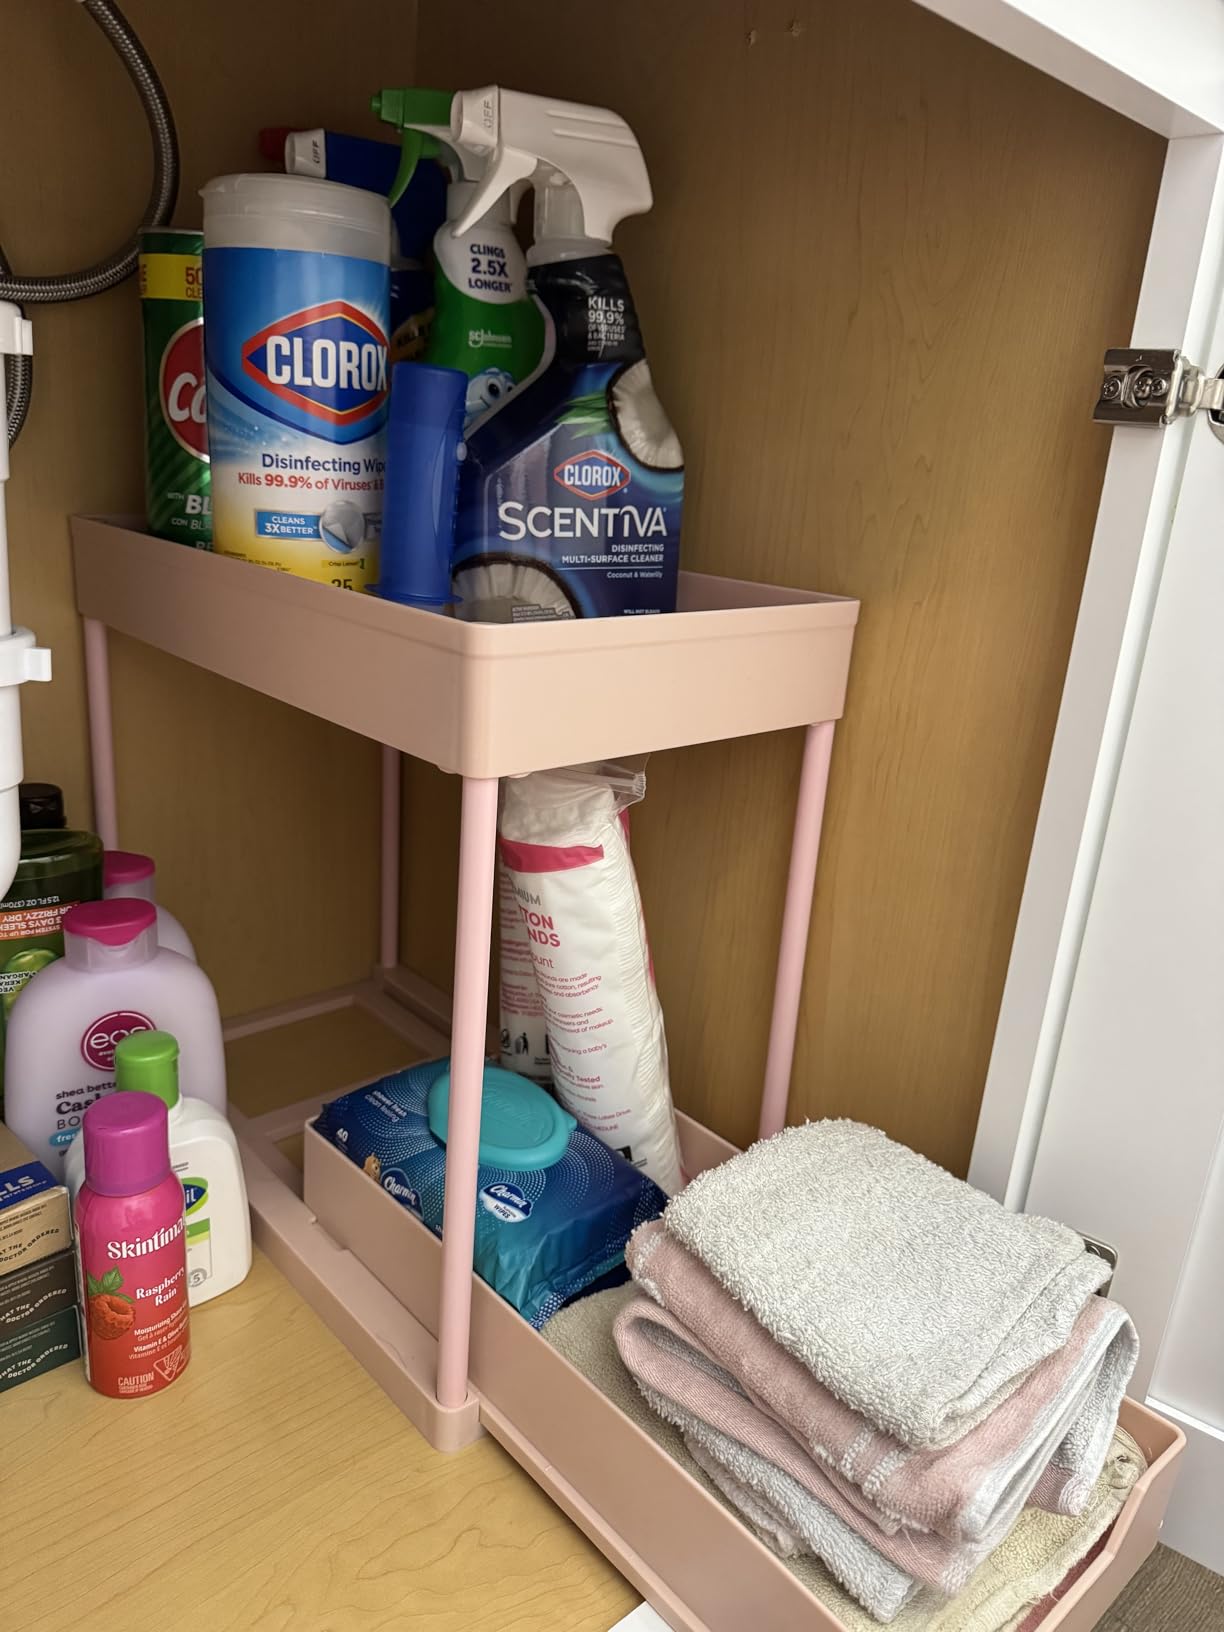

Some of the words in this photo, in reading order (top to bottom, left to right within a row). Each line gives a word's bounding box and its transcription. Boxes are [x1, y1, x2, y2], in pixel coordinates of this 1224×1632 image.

[484, 100, 492, 129] OFF
[311, 139, 321, 165] OFF
[471, 258, 509, 278] 2.5X
[468, 277, 512, 293] LONGER
[588, 295, 625, 312] KILLS
[588, 310, 625, 326] 99.9%
[266, 335, 387, 392] CLOROX
[262, 453, 361, 476] Disinfecting
[238, 472, 262, 486] Kills
[264, 474, 313, 489] 99.9%
[315, 478, 329, 490] of
[563, 464, 621, 487] CLOROX
[171, 517, 188, 527] CON
[271, 516, 305, 526] CLEANS
[498, 501, 668, 541] SCENTIVA
[264, 523, 281, 534] 3X
[281, 525, 314, 536] BETTER
[611, 544, 664, 553] DISINFECTING
[562, 554, 629, 565] MULTI-SURFACE
[630, 553, 664, 563] CLEANER
[606, 571, 633, 579] Coconut
[2, 914, 22, 922] DRY
[28, 918, 55, 928] DAYS
[56, 1086, 85, 1099] shea
[337, 1128, 349, 1142] 40
[384, 1176, 417, 1206] Charmin
[490, 1185, 528, 1208] Charmin
[136, 1266, 184, 1300] Raspberry
[193, 1273, 201, 1284] 5
[155, 1286, 177, 1307] Rain
[5, 1307, 35, 1324] DOCTOR
[34, 1288, 67, 1308] ORDERED
[16, 1303, 31, 1312] THE
[134, 1316, 171, 1336] Moisturizing
[129, 1347, 156, 1360] Vitamine
[133, 1339, 158, 1353] Vitamin
[7, 1362, 36, 1379] DOCTOR
[36, 1343, 69, 1363] ORDERED
[17, 1358, 33, 1367] THE
[118, 1372, 155, 1386] CAUTION
